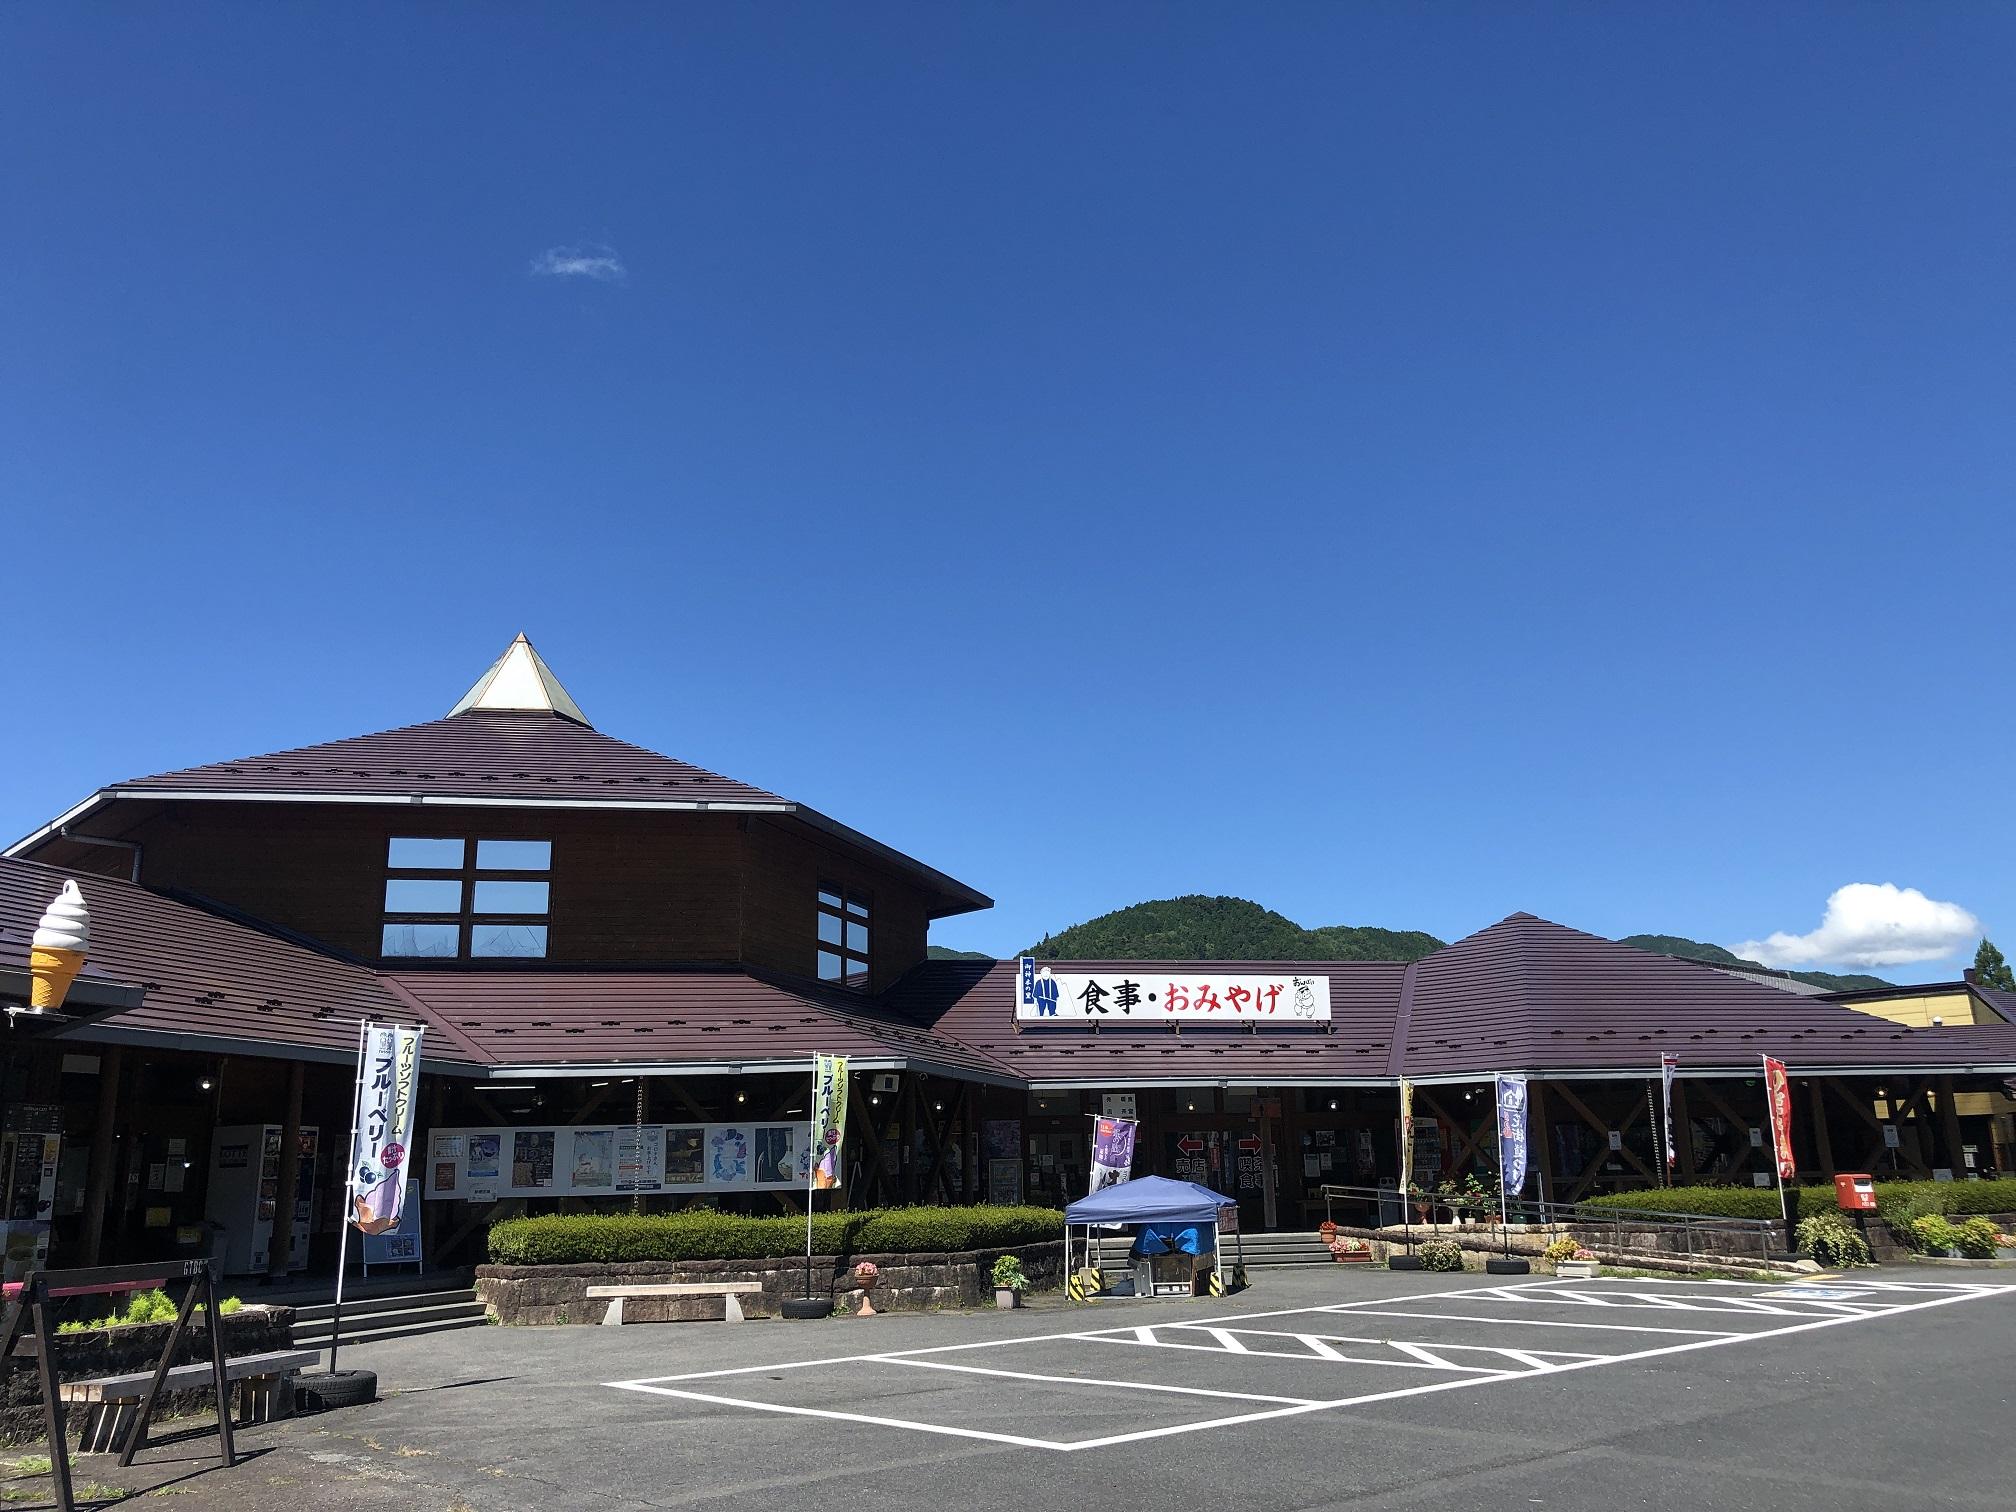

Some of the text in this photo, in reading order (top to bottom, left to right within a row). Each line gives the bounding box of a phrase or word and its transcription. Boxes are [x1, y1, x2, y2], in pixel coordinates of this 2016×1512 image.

[1077, 979, 1284, 1015] 食事・おみやげ
[368, 1056, 394, 1158] ブルーベリー
[392, 1037, 414, 1135] フルーツソフトクリーム
[820, 1075, 833, 1139] ブルーベリー
[1176, 1157, 1206, 1174] 売店
